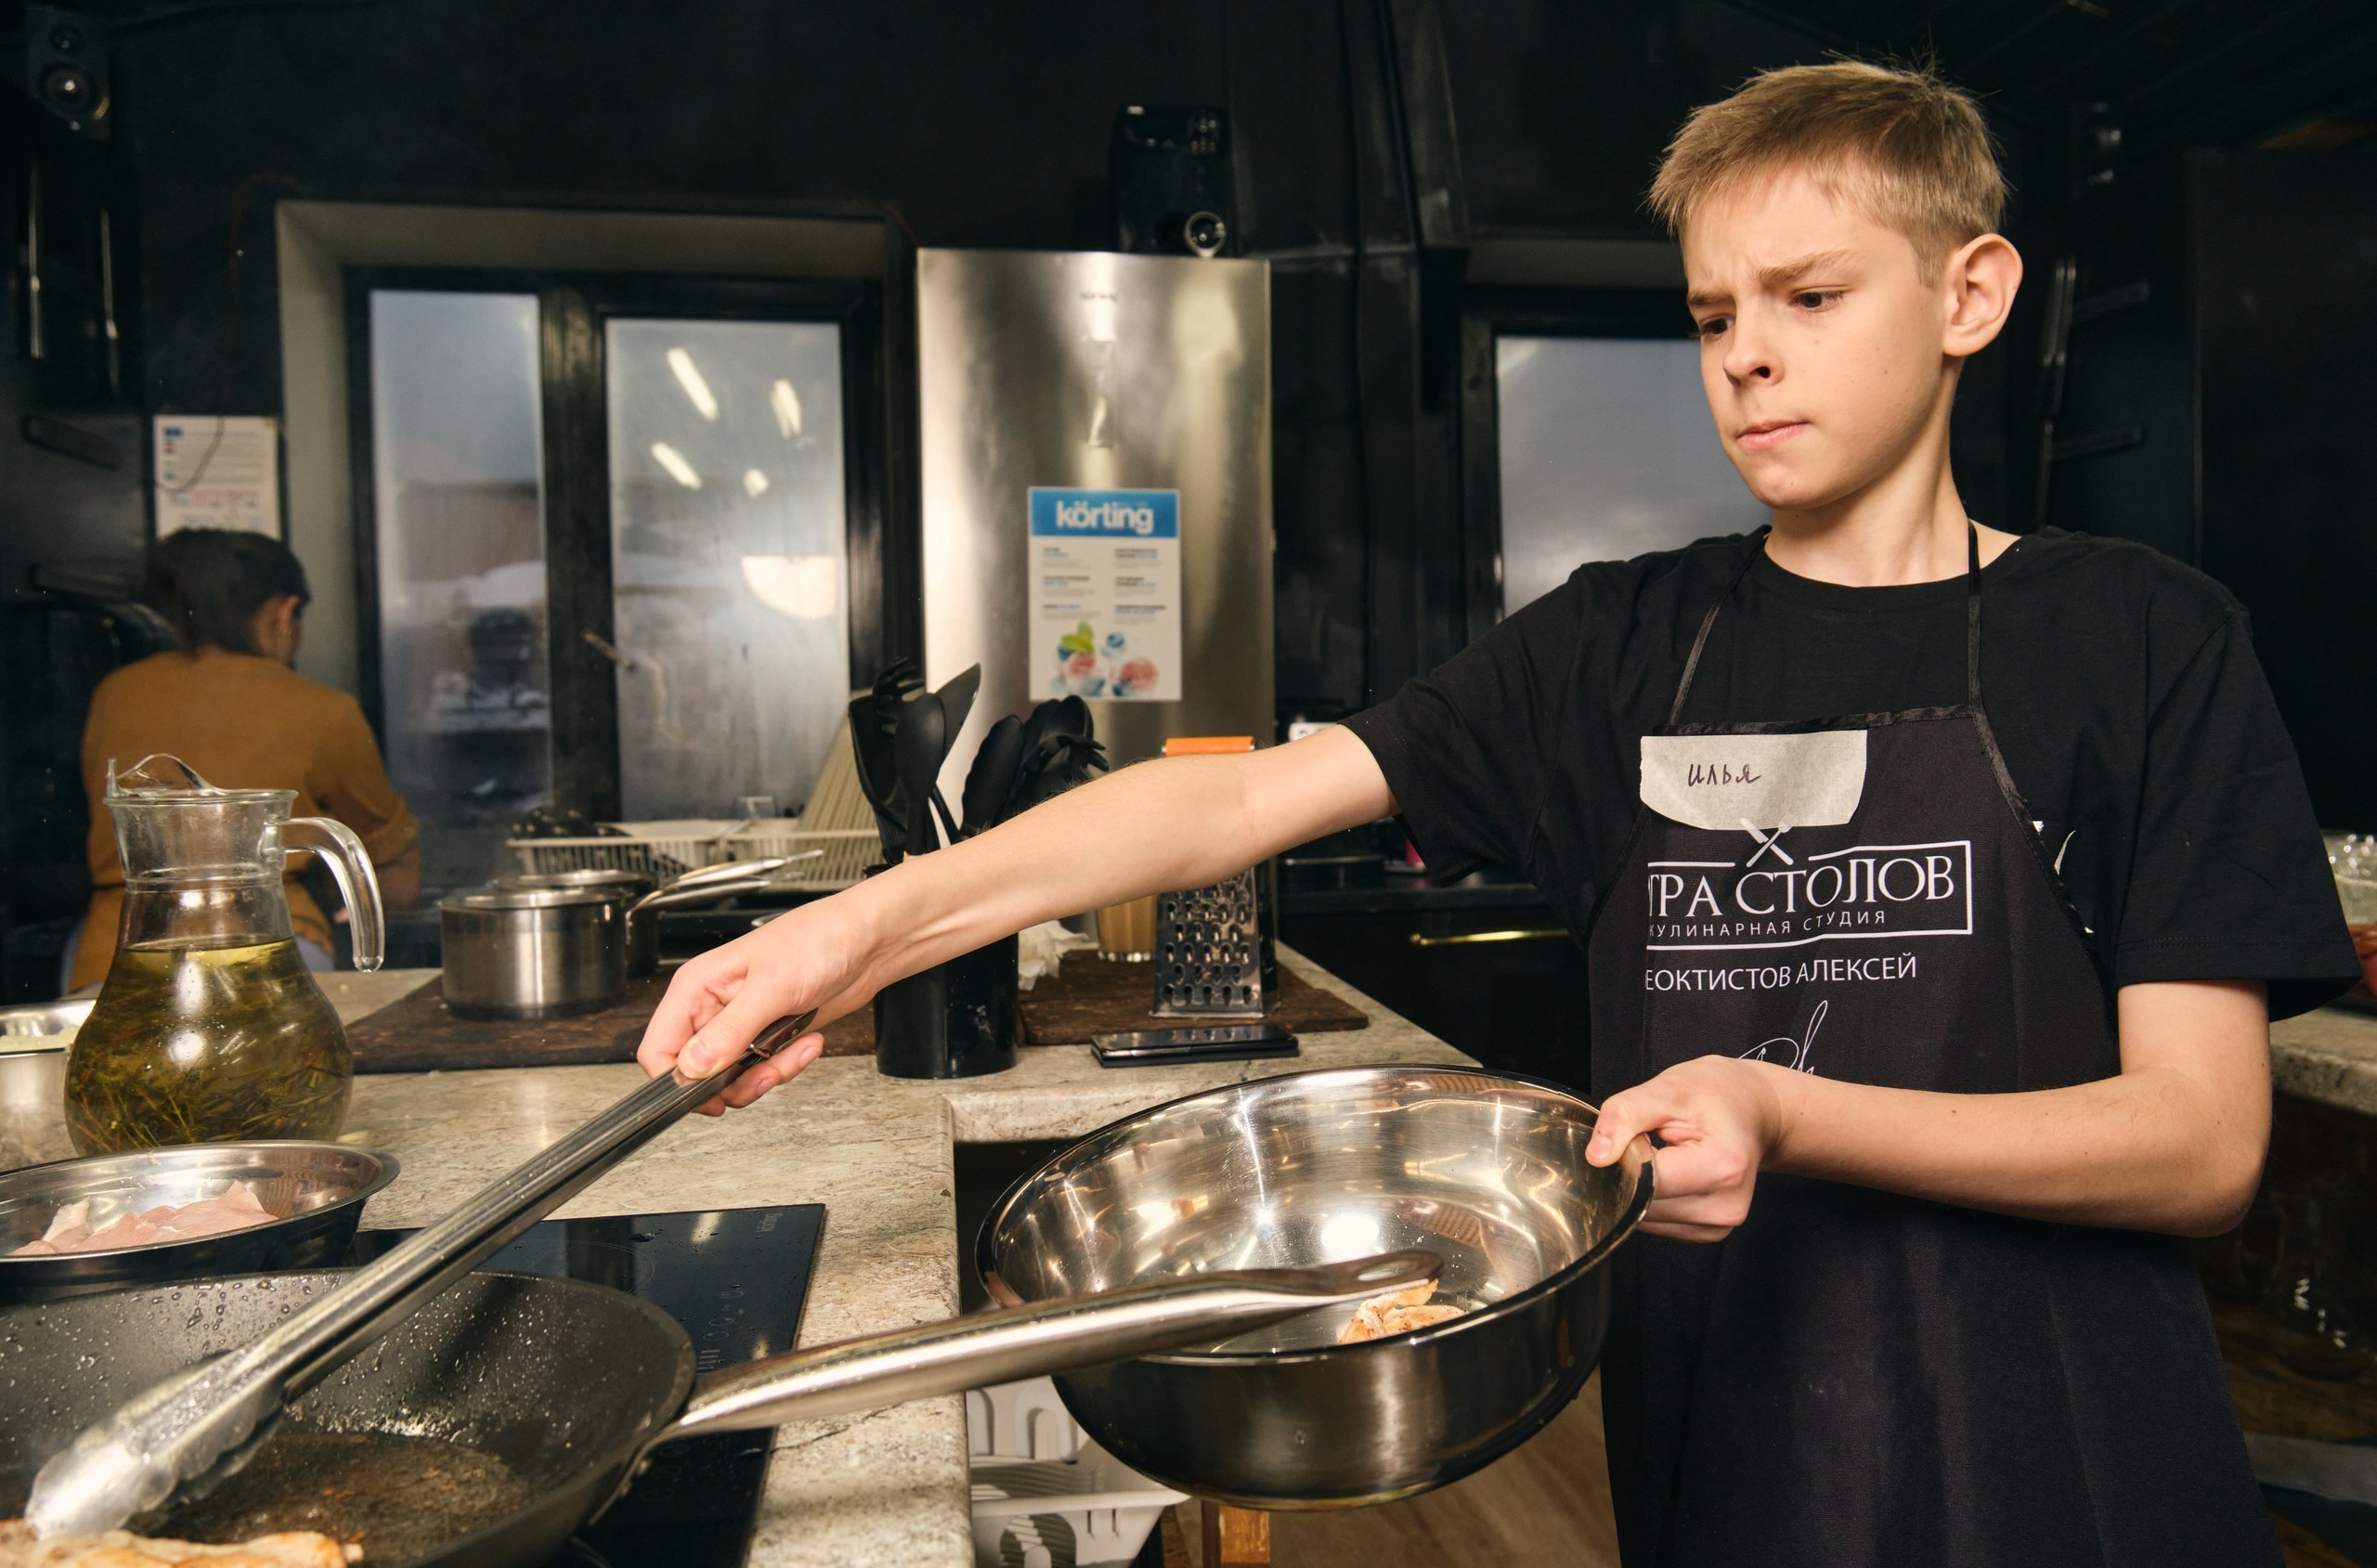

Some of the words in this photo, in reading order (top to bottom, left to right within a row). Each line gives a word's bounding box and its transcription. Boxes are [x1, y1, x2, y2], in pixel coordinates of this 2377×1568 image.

[1056, 499, 1154, 536] körting
[1735, 855, 1955, 915] СТОЛОВ
[1802, 910, 1886, 931] СТУДИЯ
[1795, 952, 1916, 985] АЛЕКСЕЙ
